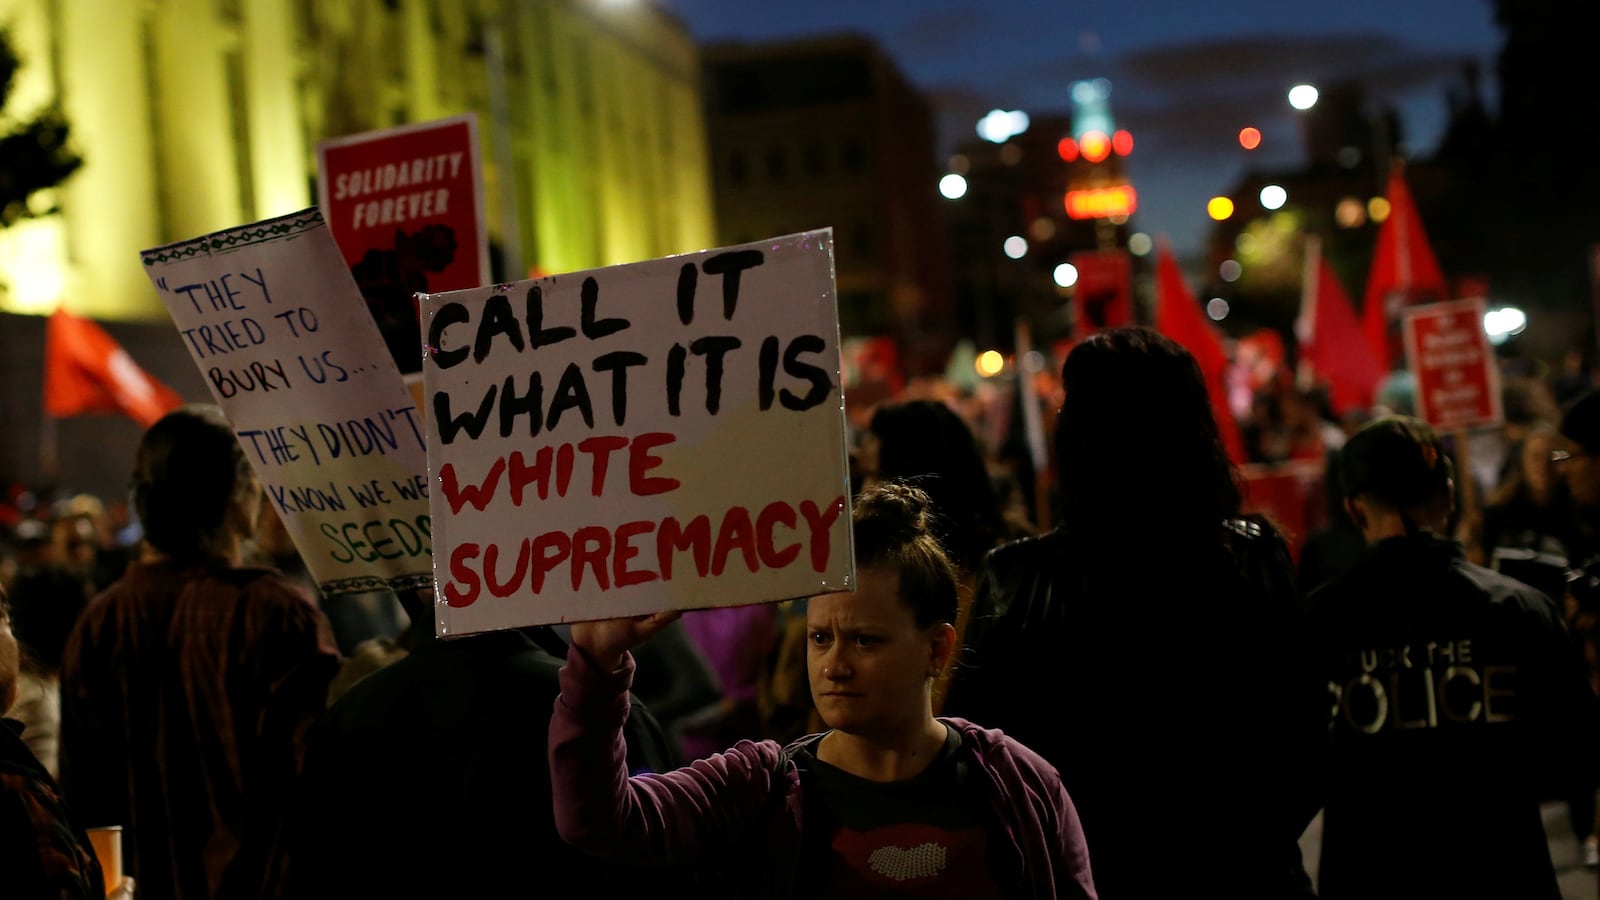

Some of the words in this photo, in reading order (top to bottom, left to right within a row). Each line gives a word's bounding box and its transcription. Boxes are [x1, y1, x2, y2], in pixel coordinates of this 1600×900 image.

[335, 152, 463, 200] SOLIDARITY
[353, 189, 449, 230] FOREVER
[182, 317, 266, 359] TRIED
[274, 308, 319, 339] TO
[428, 277, 631, 369] CALL
[677, 249, 764, 325] IT
[208, 359, 292, 398] BURY
[433, 352, 648, 444] WHAT
[666, 336, 742, 416] IT
[758, 335, 834, 411] IS
[238, 426, 320, 466] THEY
[316, 406, 427, 459] DIDN'T
[268, 481, 346, 515] KNOW
[348, 480, 391, 508] WE
[392, 475, 429, 500] WE
[439, 432, 681, 515] WHITE
[319, 515, 432, 563] SEEDS
[444, 496, 846, 608] SUPREMACY
[1360, 644, 1414, 673] UCK
[1426, 638, 1472, 666] THE
